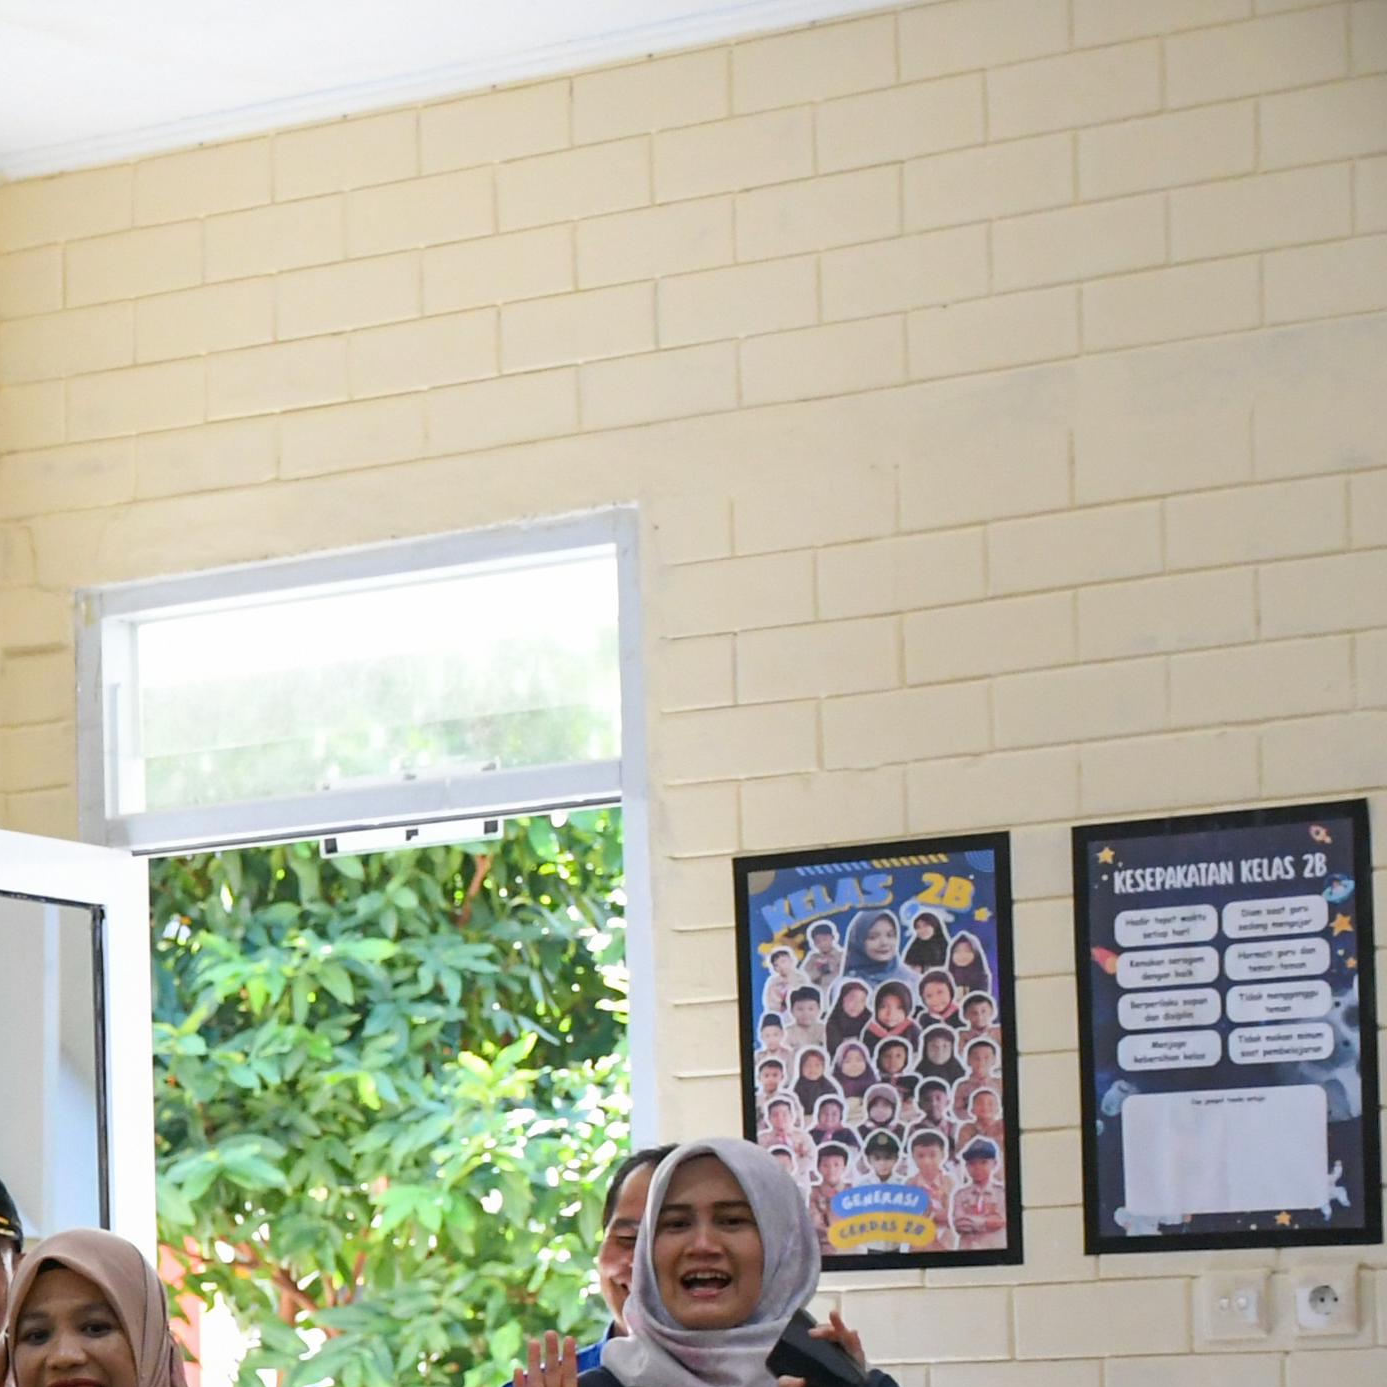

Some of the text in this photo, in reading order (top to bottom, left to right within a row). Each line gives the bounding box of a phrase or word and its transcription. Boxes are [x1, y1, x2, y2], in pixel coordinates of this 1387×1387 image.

[1113, 852, 1327, 894] KESEPAKATAN KELAS 2B
[761, 872, 974, 937] KELAS 2B
[841, 1190, 920, 1210] GENERASI
